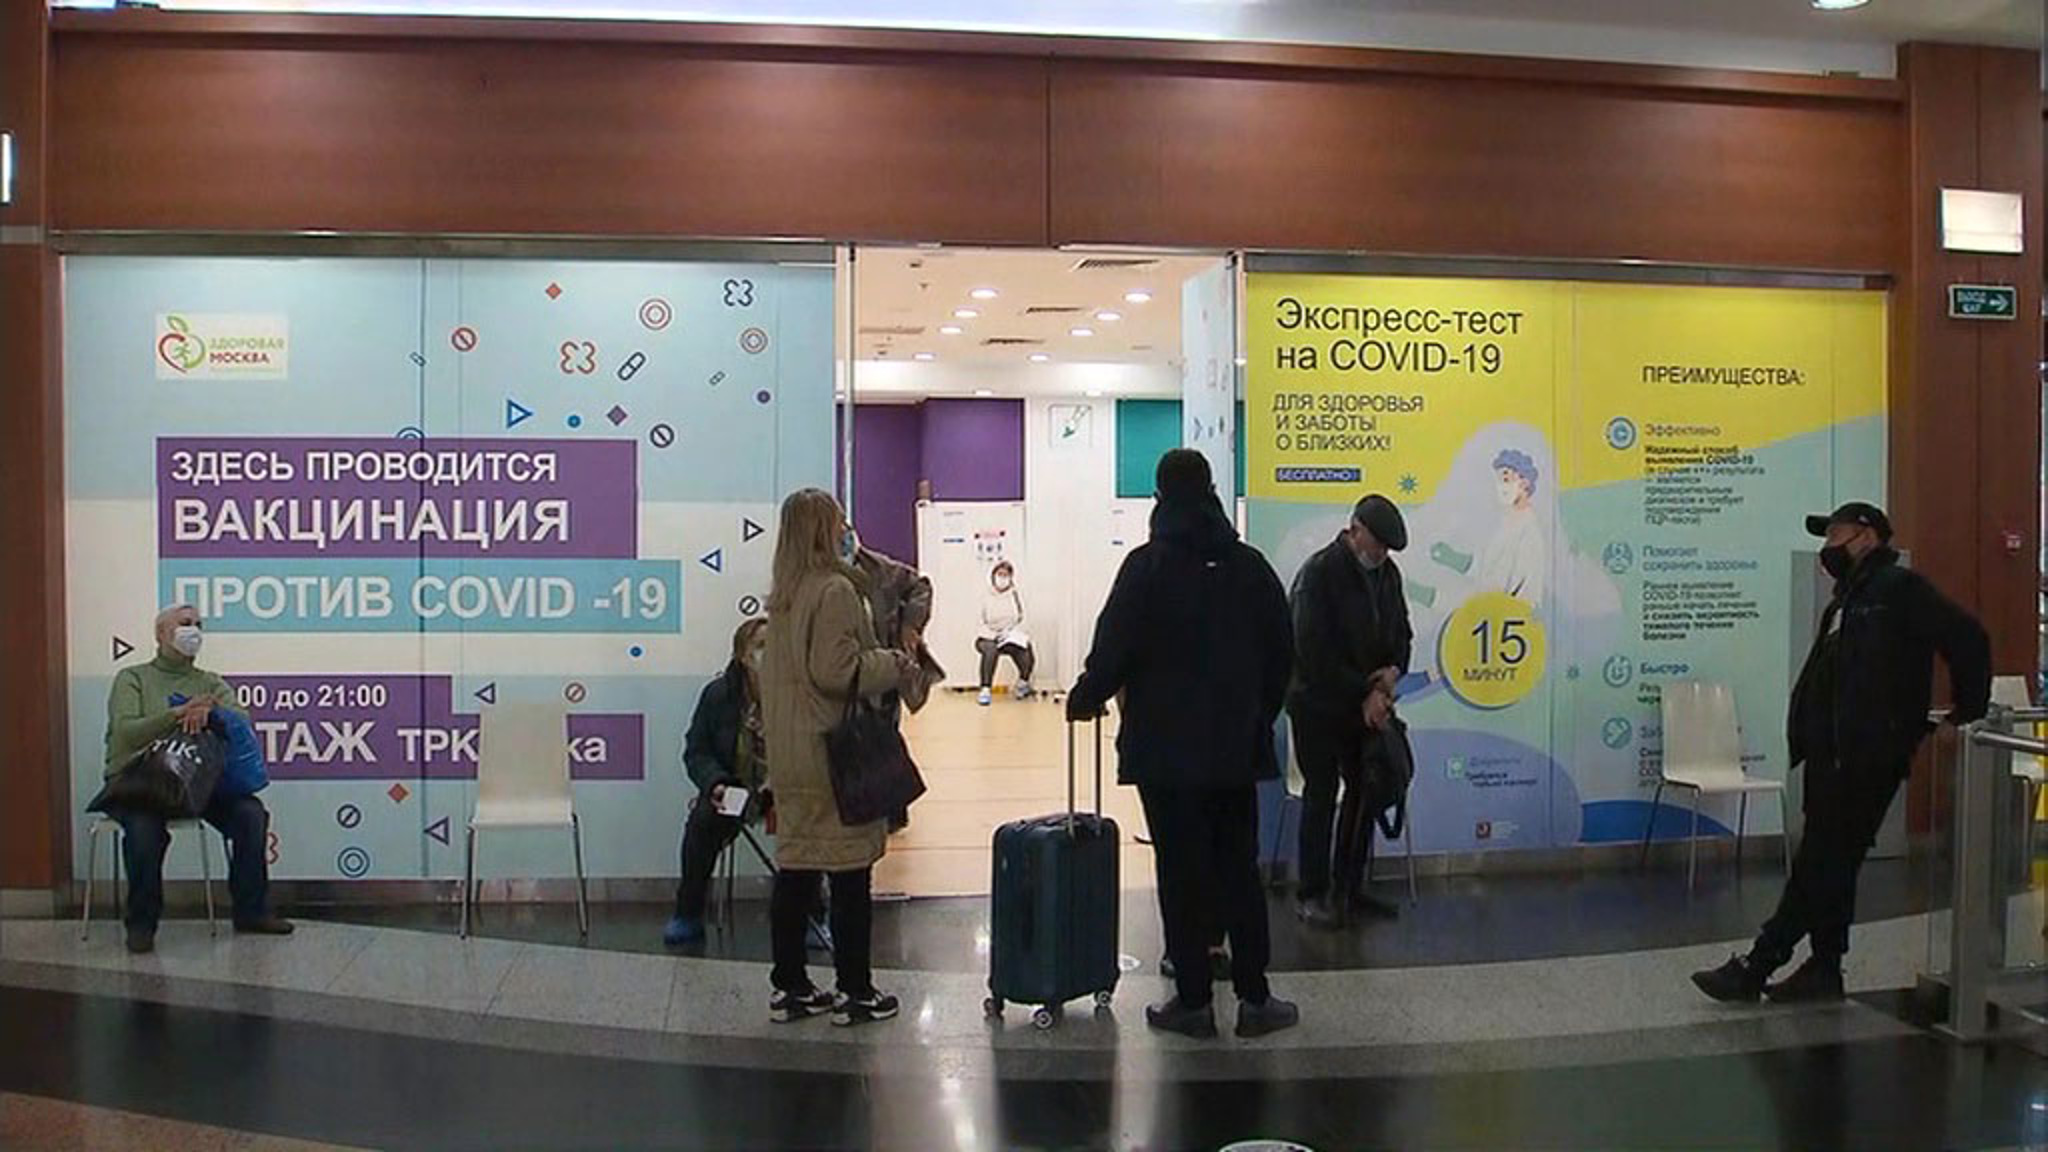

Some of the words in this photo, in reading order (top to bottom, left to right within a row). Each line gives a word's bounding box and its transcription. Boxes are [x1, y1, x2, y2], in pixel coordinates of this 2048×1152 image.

[1276, 297, 1524, 337] Экспресс-тест
[208, 352, 271, 364] МОСКВА
[1276, 346, 1318, 371] на
[1330, 339, 1502, 374] COVID-19
[1642, 365, 1806, 388] ПРЕИМУЩЕСТВА:
[1272, 393, 1314, 413] ДЛЯ
[1318, 393, 1425, 413] ЗДОРОВЬЯ
[1275, 414, 1290, 431] И
[1295, 414, 1377, 431] ЗАБОТЫ
[1275, 433, 1292, 451] О
[1296, 434, 1392, 451] БЛИЗКИХ!
[171, 452, 294, 486] ЗДЕСЬ
[307, 452, 557, 487] ПРОВОДИТСЯ
[174, 499, 569, 549] ВАКЦИНАЦИЯ
[174, 576, 393, 619] ПРОТИВ
[411, 576, 576, 619] COVID
[593, 577, 668, 619] -19
[1471, 619, 1527, 665] 15
[274, 689, 308, 708] до
[318, 685, 388, 707] 21:00
[255, 721, 376, 763] ТАЖ
[396, 729, 480, 763] ТРК
